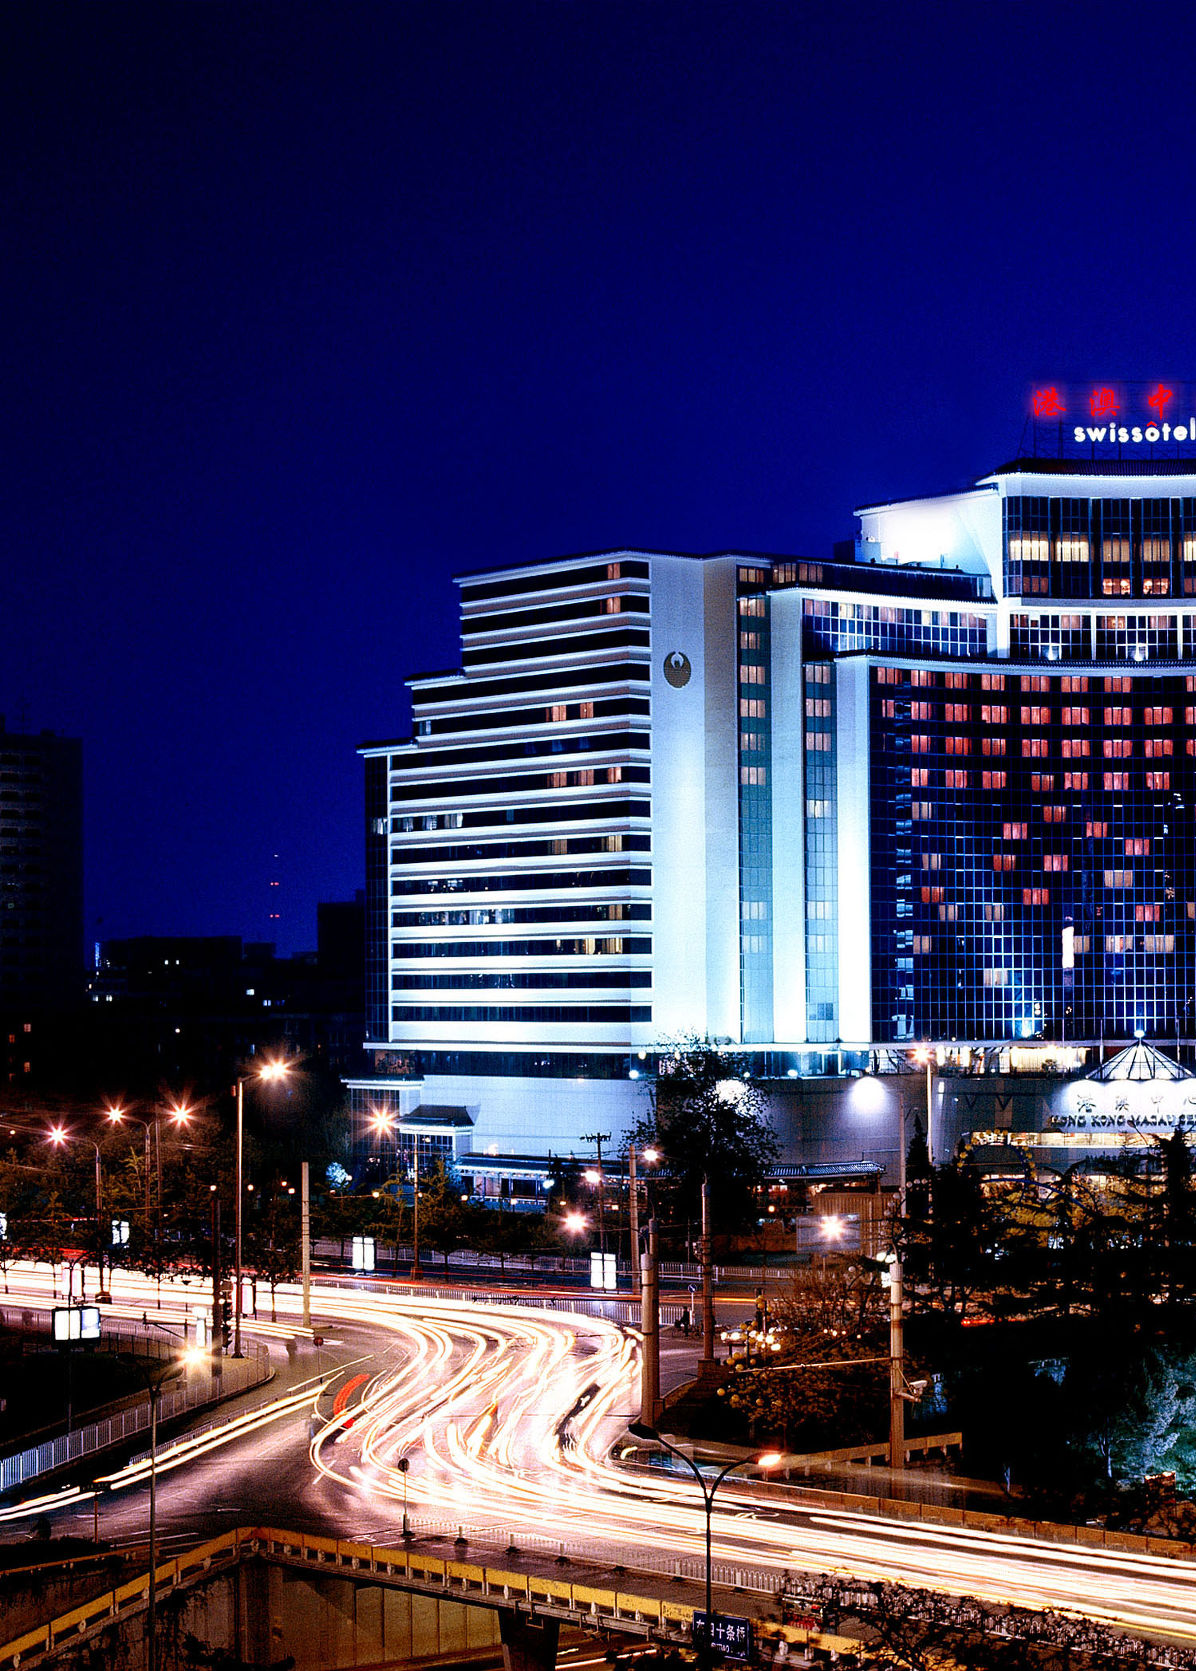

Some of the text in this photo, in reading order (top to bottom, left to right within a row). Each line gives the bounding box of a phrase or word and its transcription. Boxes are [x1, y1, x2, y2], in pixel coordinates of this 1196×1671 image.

[1073, 417, 1196, 443] swissôtel
[1050, 1114, 1087, 1128] HONG
[1091, 1114, 1125, 1128] KONG
